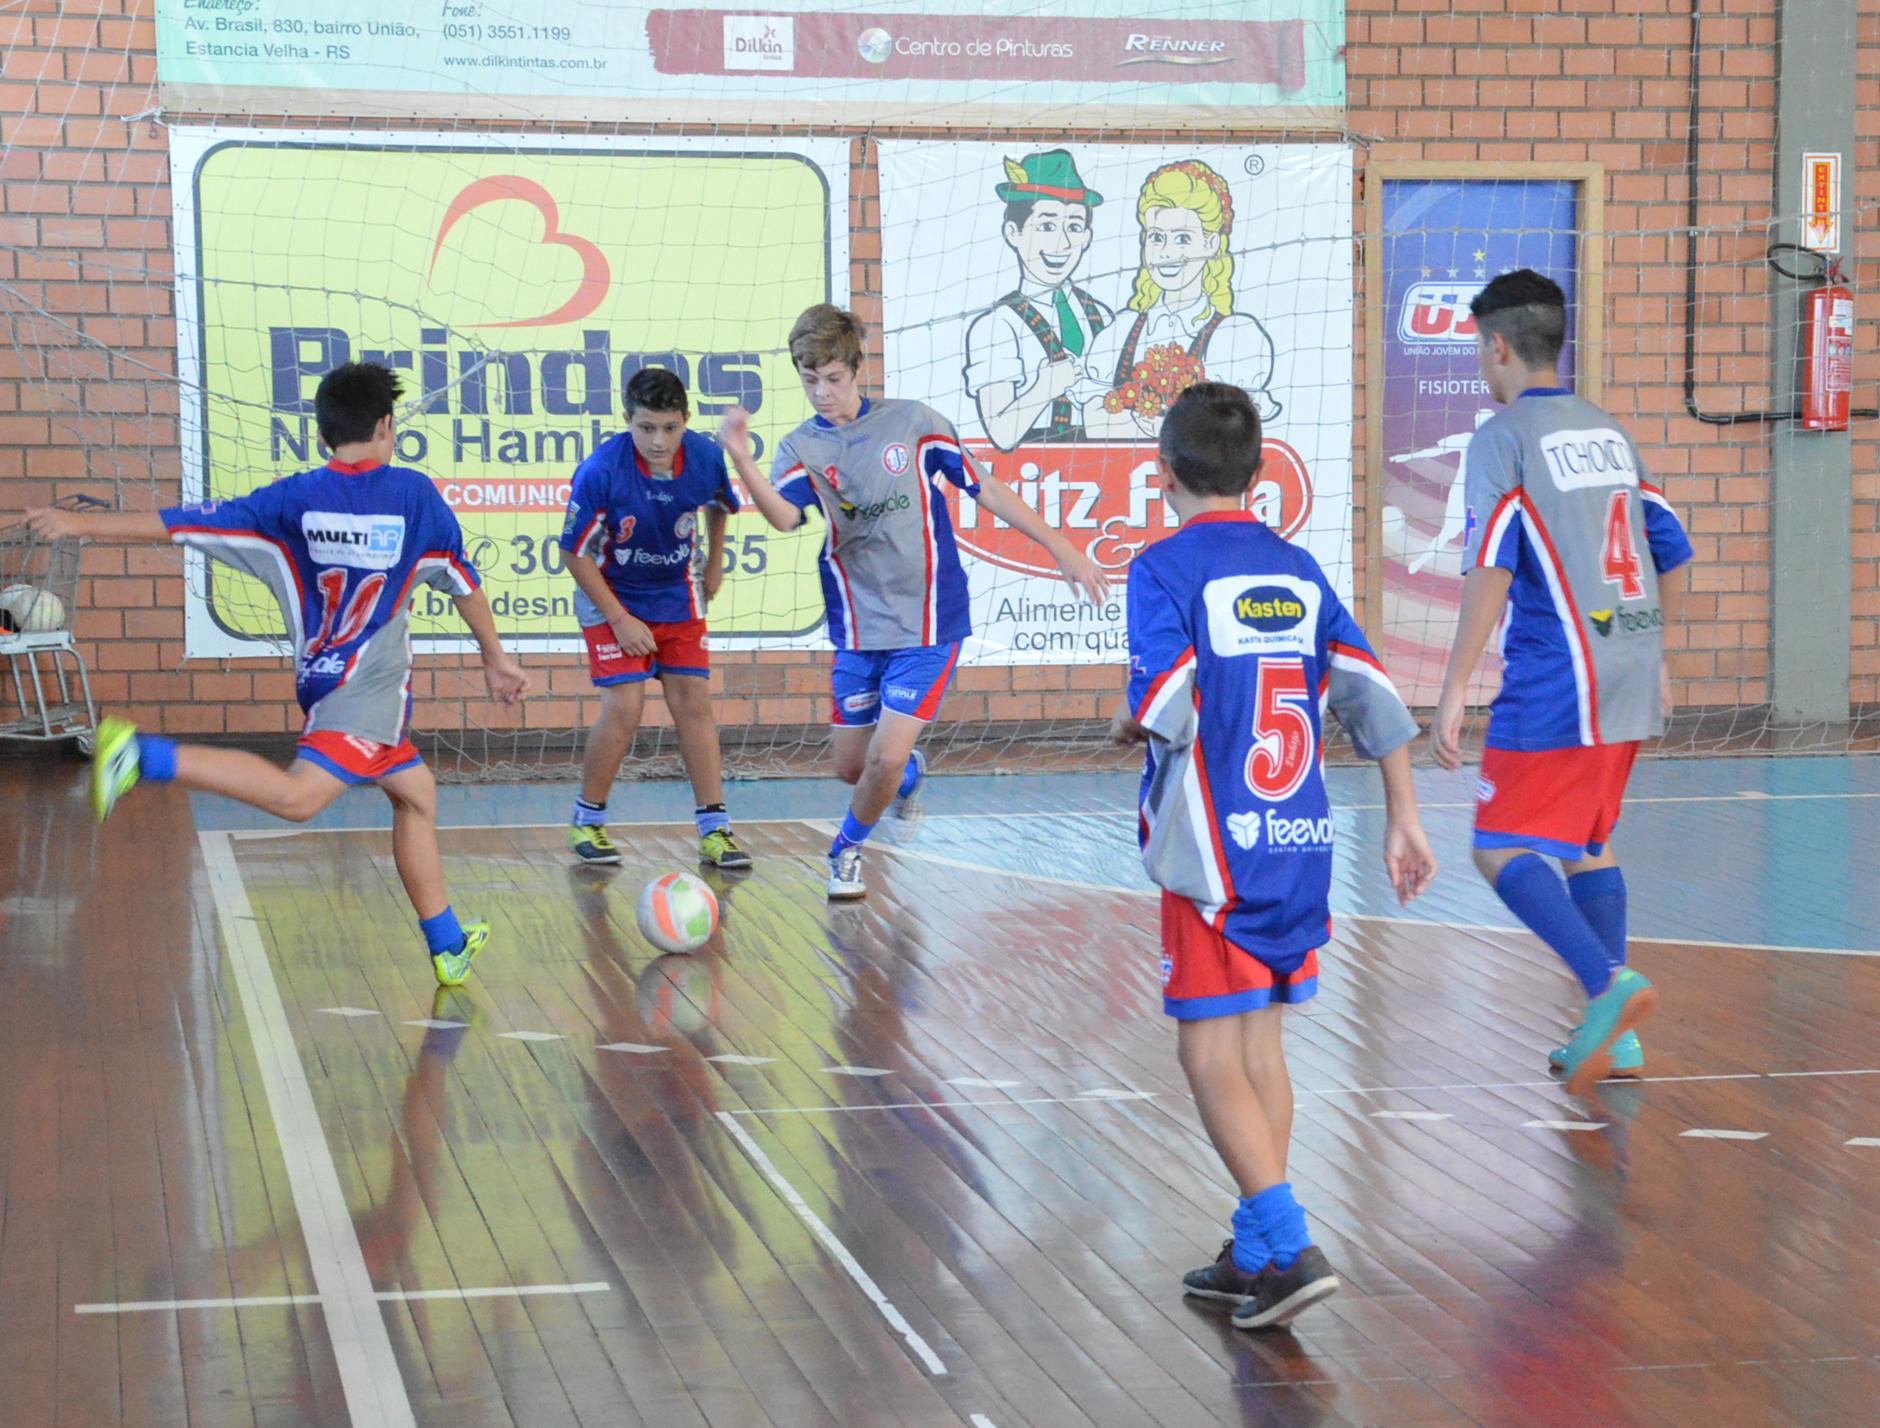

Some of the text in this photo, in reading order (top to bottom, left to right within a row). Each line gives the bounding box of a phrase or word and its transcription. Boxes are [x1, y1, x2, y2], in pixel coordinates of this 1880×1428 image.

[185, 16, 420, 39] Av. Brasil, 830, bairro União,
[443, 24, 571, 41] (051) 3551.1199
[186, 41, 259, 57] Estancia
[263, 43, 310, 58] Velha
[326, 45, 351, 60] RS
[735, 37, 782, 53] Dilkin
[895, 36, 1074, 58] Centro de Pinturas
[1124, 33, 1226, 53] RENNER
[444, 55, 608, 70] www.dilkintintas.com.br
[1403, 345, 1476, 356] UNIÃO JOVEM DO
[1418, 380, 1491, 395] FISIOTER
[271, 417, 428, 463] No
[824, 465, 839, 490] 3
[442, 484, 573, 506] COMUNIC
[616, 515, 637, 544] 3
[1086, 515, 1147, 570] &
[1599, 488, 1647, 601] 4
[303, 567, 388, 659] 10
[996, 597, 1121, 623] Alimente
[1236, 597, 1303, 620] Kasten
[1014, 632, 1074, 651] com
[1244, 656, 1315, 802] 5
[1265, 808, 1334, 846] feeval
